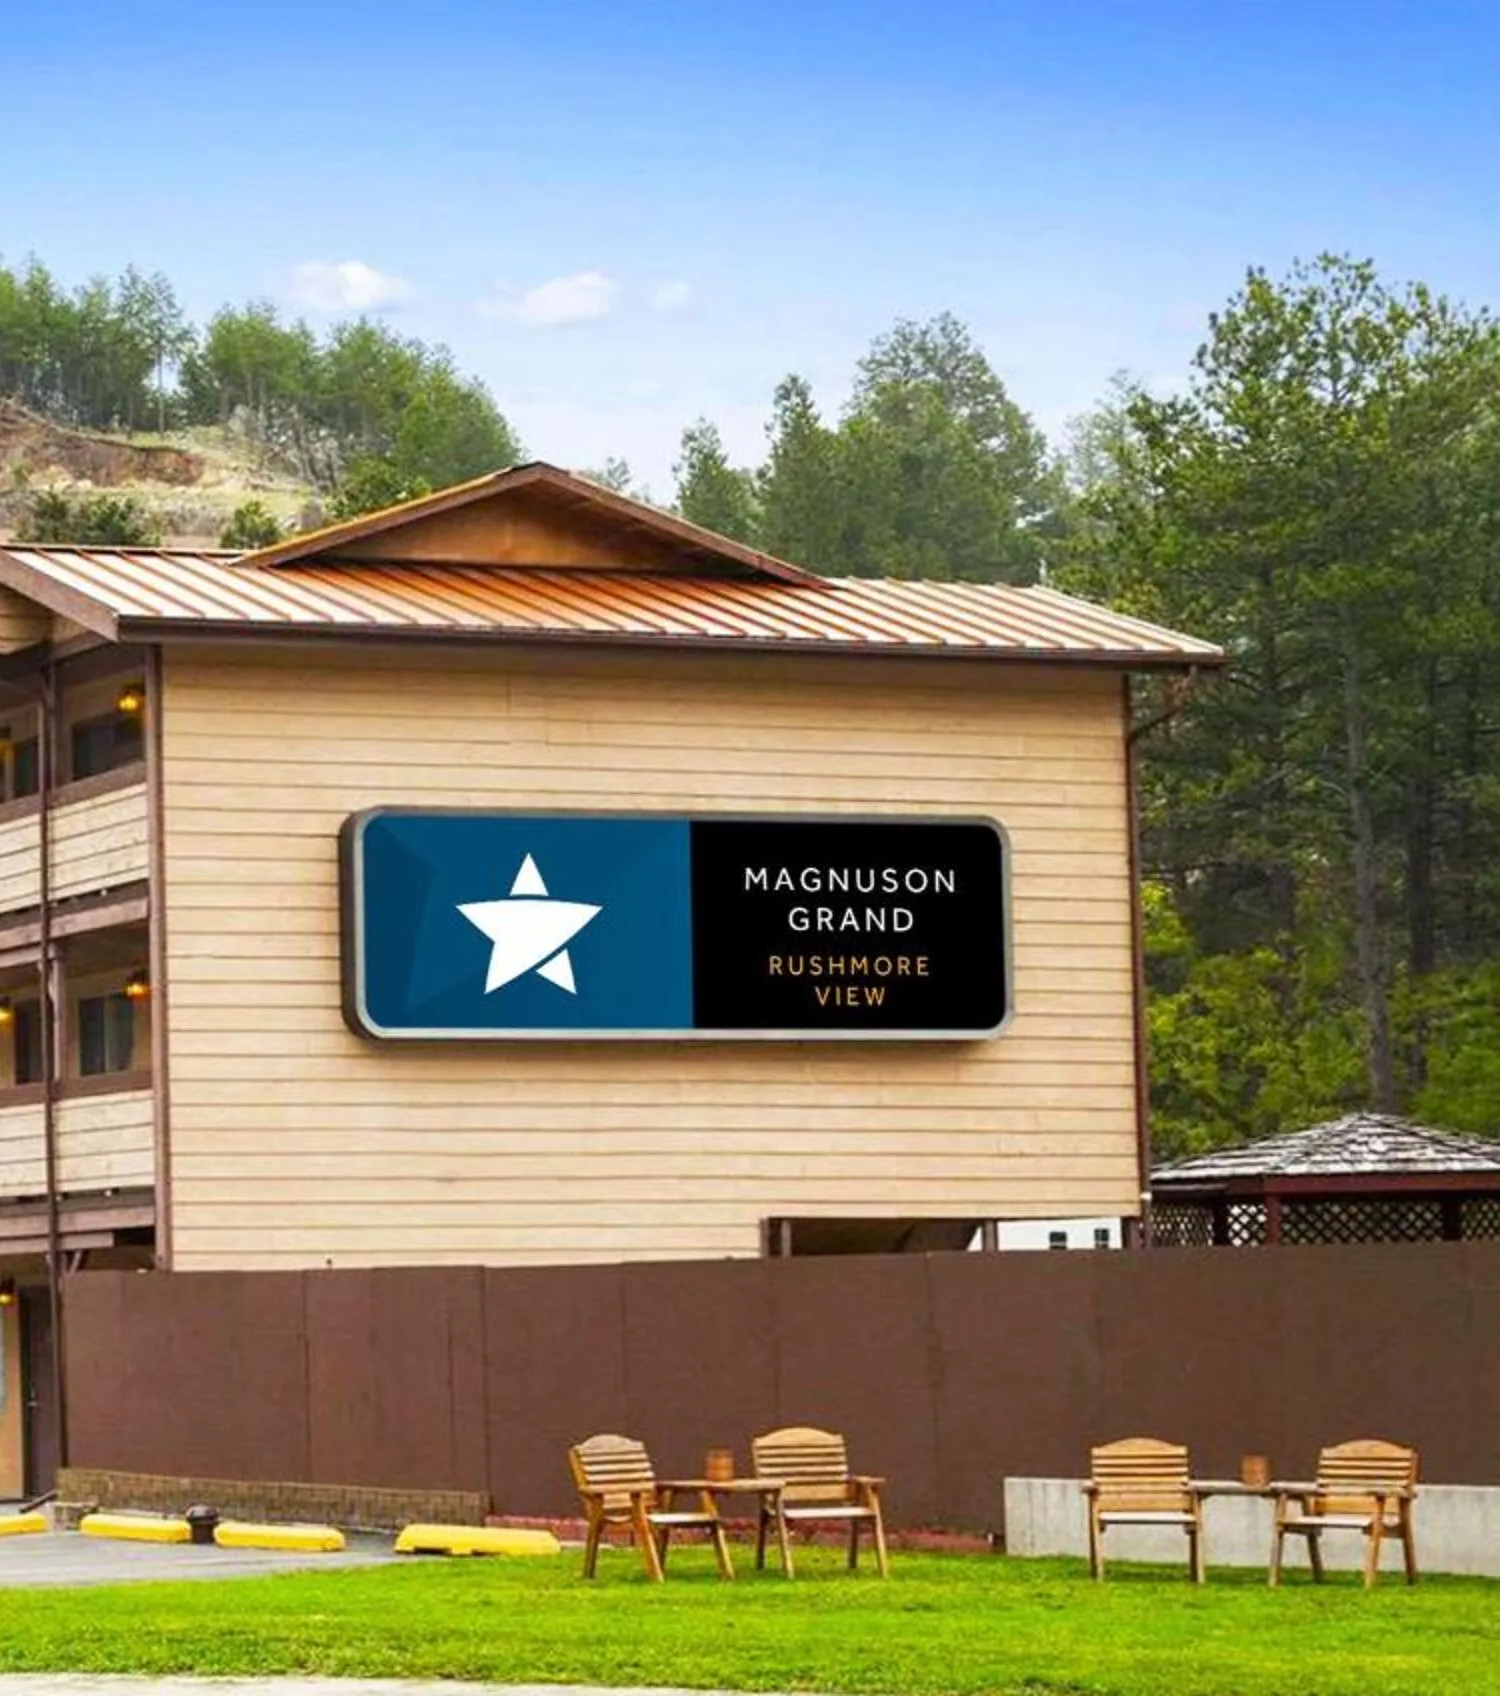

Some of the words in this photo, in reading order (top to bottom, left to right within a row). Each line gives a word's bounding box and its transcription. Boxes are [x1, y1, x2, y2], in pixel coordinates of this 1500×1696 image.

[745, 867, 955, 893] MAGNUSON
[788, 906, 914, 932] GRAND
[769, 955, 929, 976] RUSHMORE
[815, 987, 886, 1006] VIEW
